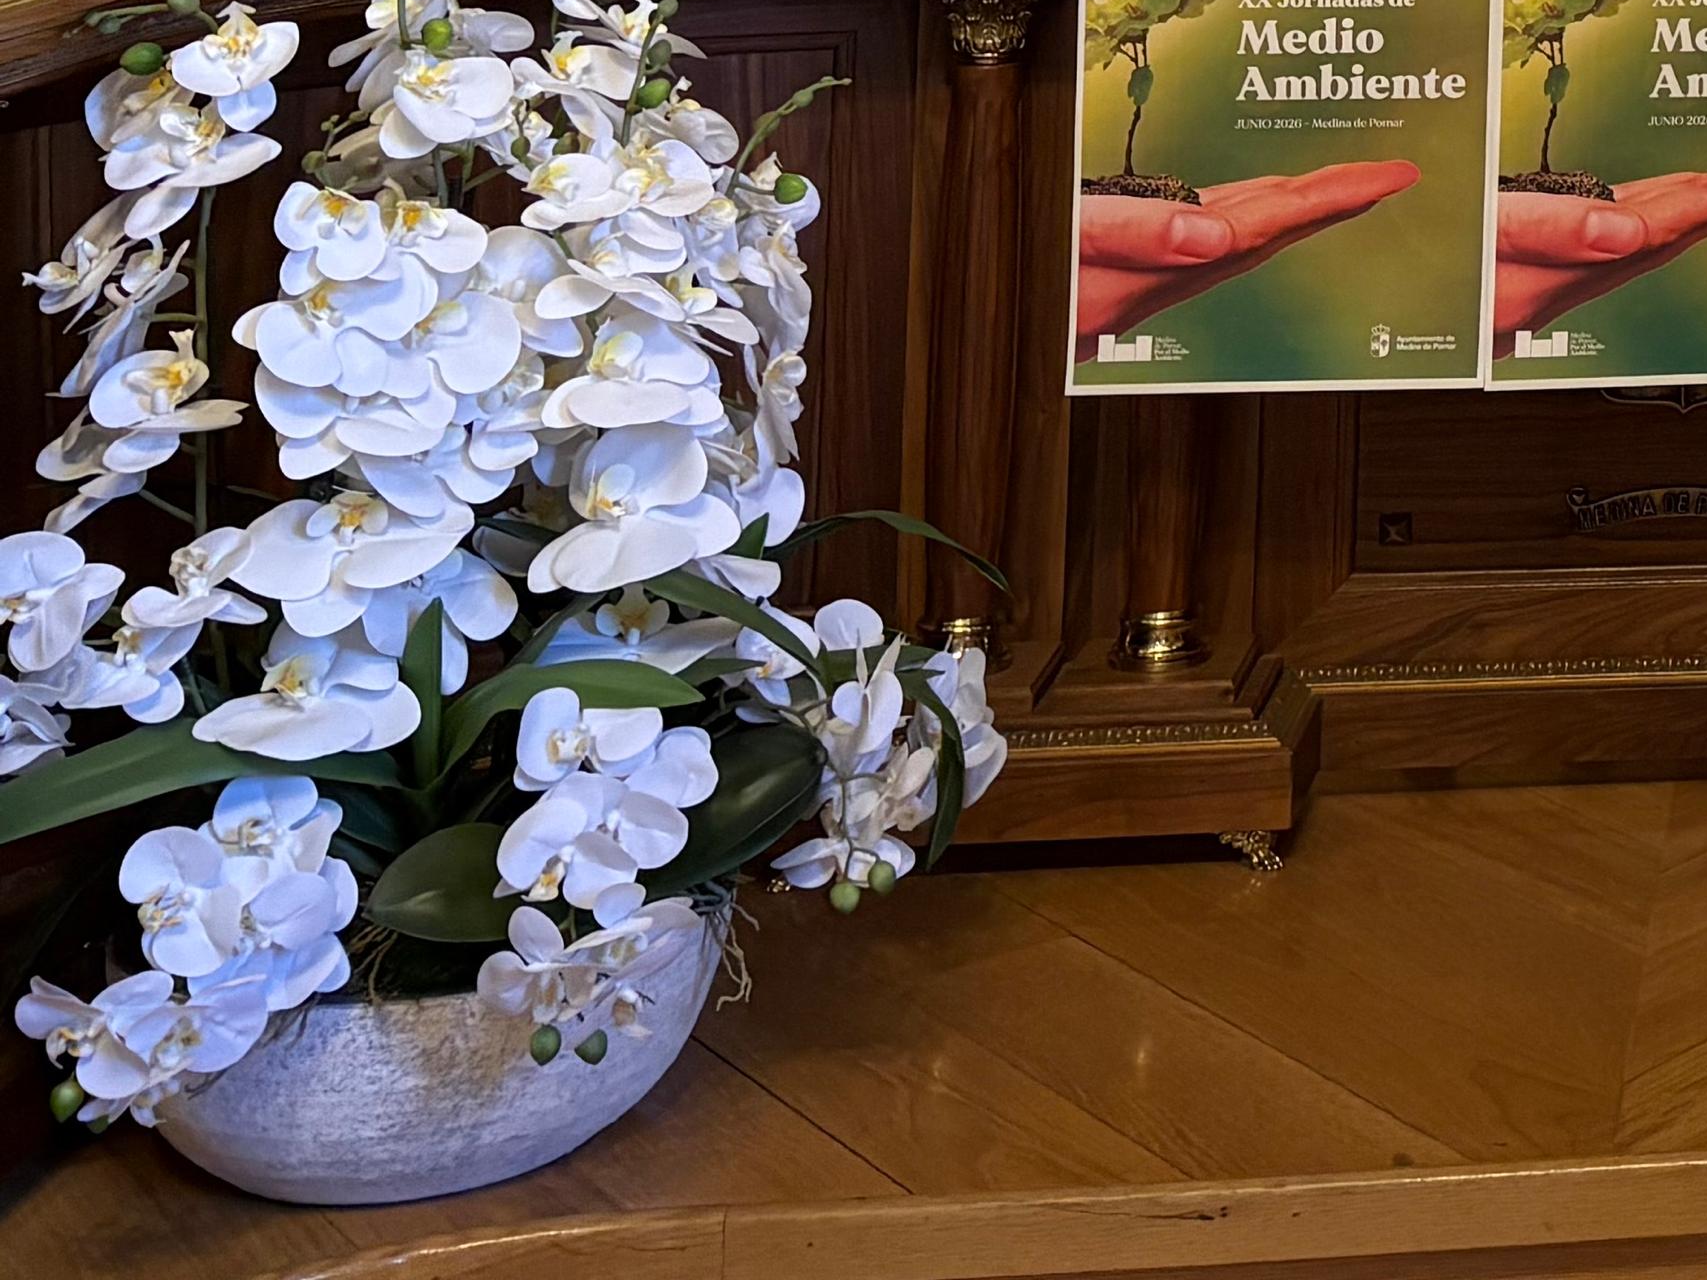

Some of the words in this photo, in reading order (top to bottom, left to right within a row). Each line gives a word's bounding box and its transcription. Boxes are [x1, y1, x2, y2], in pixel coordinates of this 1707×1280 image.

[1236, 16, 1385, 56] Medio
[1235, 62, 1468, 102] Ambiente
[1234, 118, 1272, 130] JUNIO
[1273, 118, 1303, 130] 2026
[1311, 117, 1352, 129] Medina
[1353, 117, 1367, 129] de
[1368, 117, 1405, 129] Pomar
[1648, 115, 1684, 127] JUNIO
[1662, 491, 1690, 515] DE
